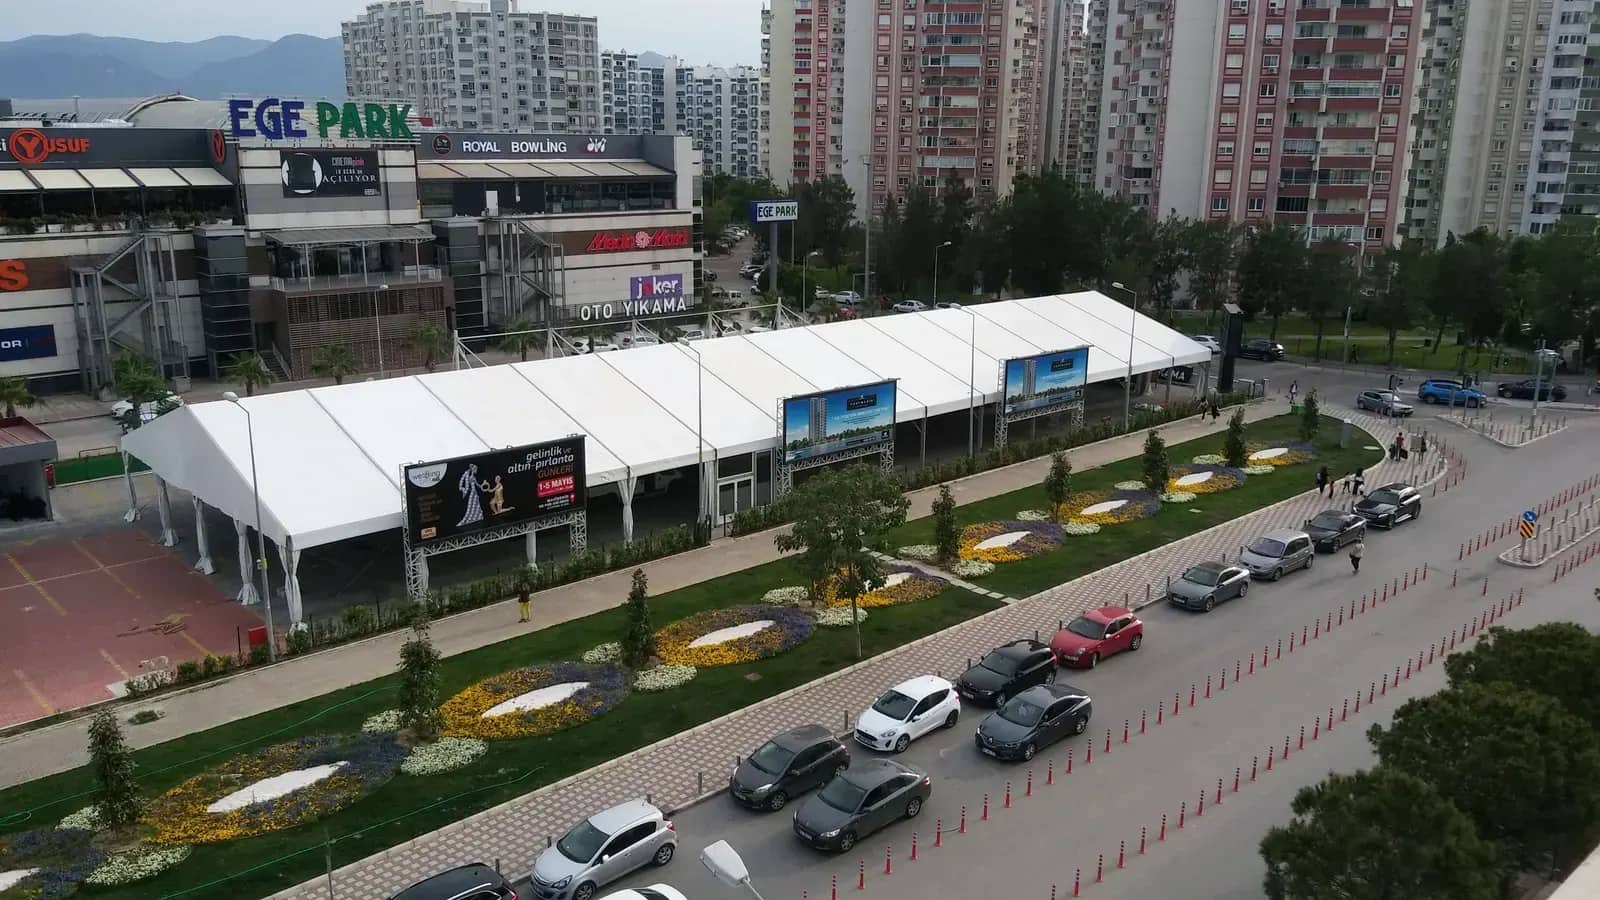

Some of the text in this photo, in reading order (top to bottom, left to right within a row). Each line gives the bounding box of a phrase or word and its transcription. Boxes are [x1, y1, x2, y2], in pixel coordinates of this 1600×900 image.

[228, 98, 414, 140] EGE PARK
[462, 140, 501, 153] ROYAL
[322, 174, 377, 185] AÇILIYOR
[757, 205, 798, 218] EGE PARK
[580, 297, 687, 321] OTO YIKAMA
[526, 446, 562, 464] gelinlik
[551, 476, 574, 489] MAYIS
